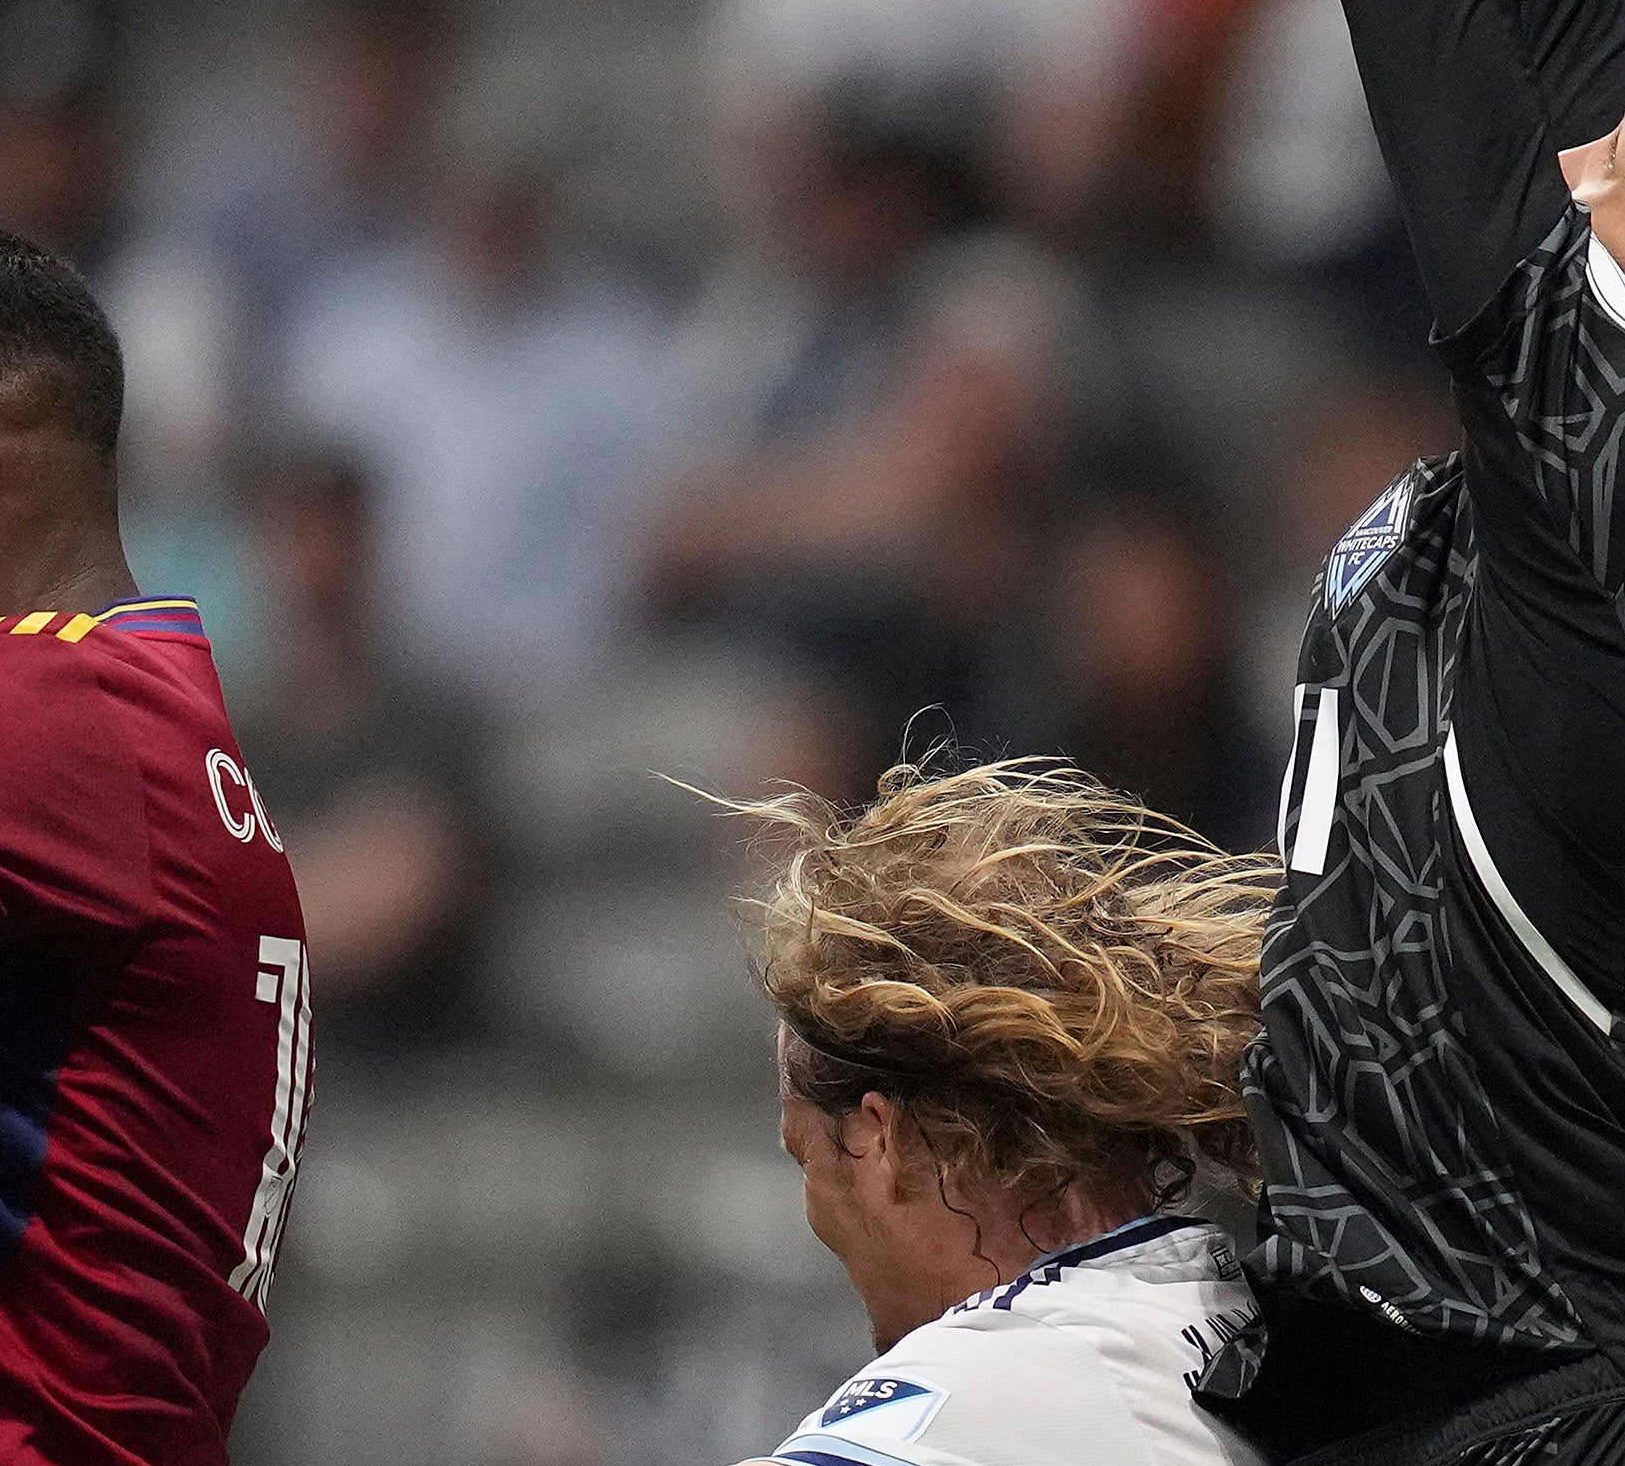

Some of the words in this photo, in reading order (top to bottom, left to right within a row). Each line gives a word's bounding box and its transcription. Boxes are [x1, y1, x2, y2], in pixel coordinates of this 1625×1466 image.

[1336, 535, 1399, 563] WHITECAPS
[1348, 551, 1365, 566] FC
[842, 1380, 898, 1400] MLS
